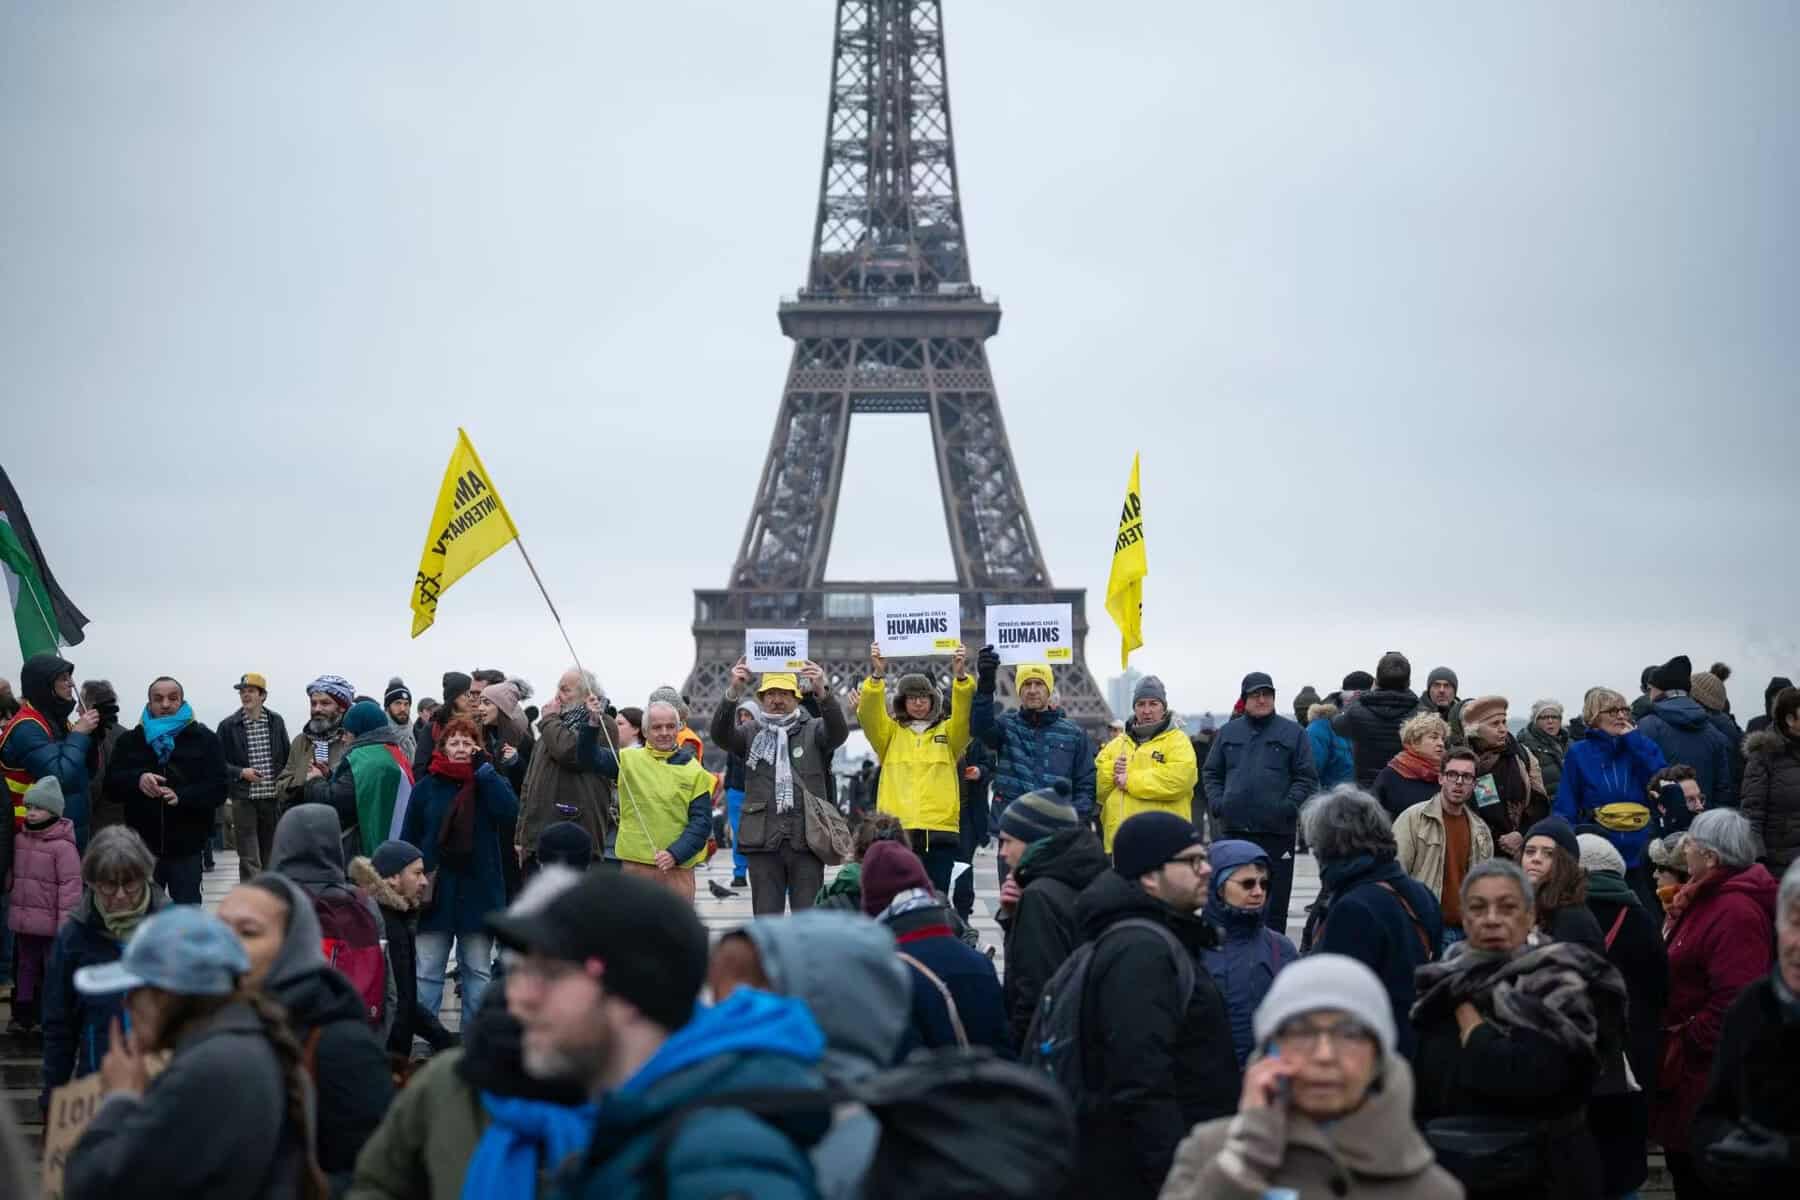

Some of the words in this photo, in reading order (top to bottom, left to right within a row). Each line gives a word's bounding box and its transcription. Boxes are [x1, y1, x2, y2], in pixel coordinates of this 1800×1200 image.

[887, 618, 948, 635] HUMAINS
[998, 627, 1060, 643] HUMAINS
[754, 646, 796, 657] HUMAINS
